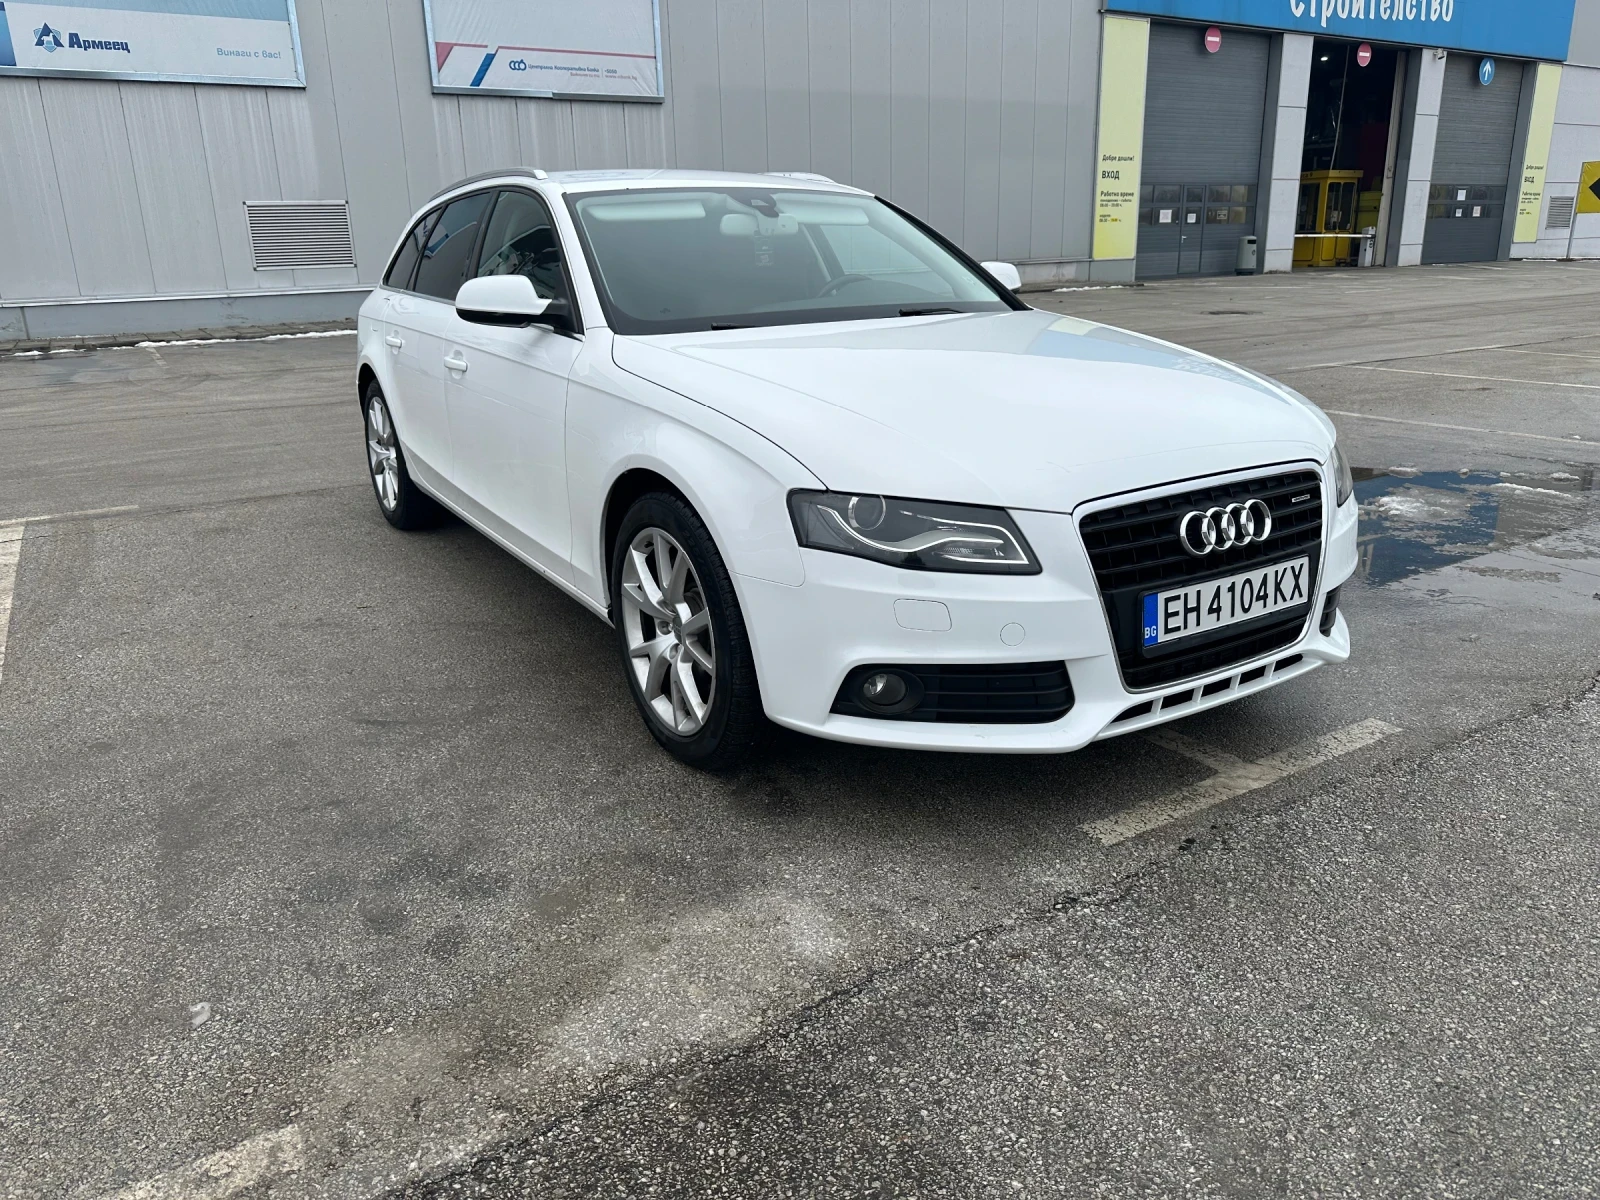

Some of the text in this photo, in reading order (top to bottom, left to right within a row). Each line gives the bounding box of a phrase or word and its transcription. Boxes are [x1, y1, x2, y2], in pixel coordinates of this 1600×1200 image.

[68, 32, 131, 53] Армеец
[217, 47, 282, 59] Винаги с вас!
[1102, 154, 1117, 162] Добре
[1101, 170, 1120, 180] ВХОД
[1144, 625, 1157, 639] BG
